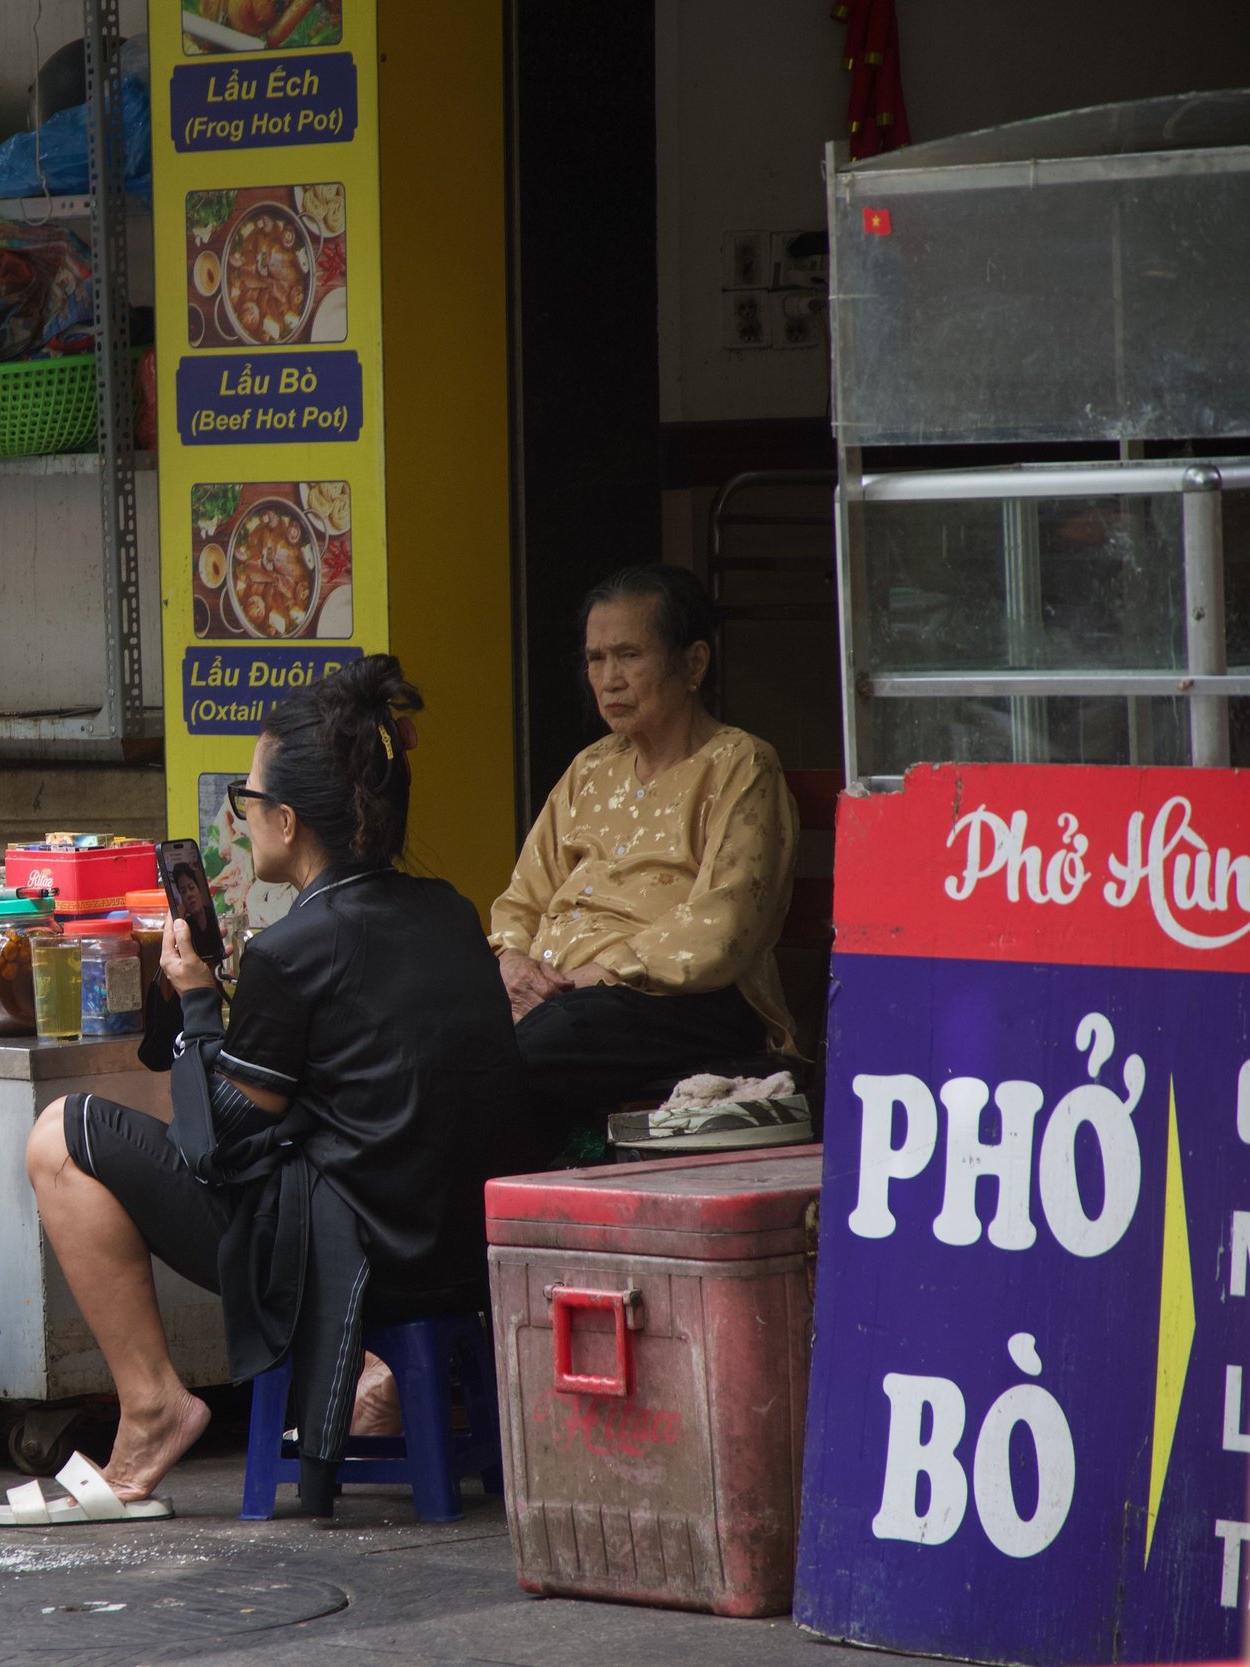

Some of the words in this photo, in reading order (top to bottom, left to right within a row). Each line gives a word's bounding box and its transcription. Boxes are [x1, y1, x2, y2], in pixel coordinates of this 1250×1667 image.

[207, 69, 257, 102] Lẩu
[266, 65, 319, 98] Ếch
[185, 117, 244, 144] (Frog
[251, 113, 291, 135] Hot
[298, 107, 344, 135] Pot)
[219, 363, 269, 396] Lẩu
[279, 366, 318, 394] Bò
[191, 408, 252, 436] (Beef
[255, 408, 296, 430] Hot
[302, 405, 348, 433] Pot)
[190, 656, 240, 687] Lẩu
[248, 660, 315, 687] Đuôi
[190, 699, 264, 725] (Oxtail
[944, 804, 1091, 906] Phở
[848, 1012, 1146, 1258] PHỞ
[872, 1332, 1076, 1559] BÒ
